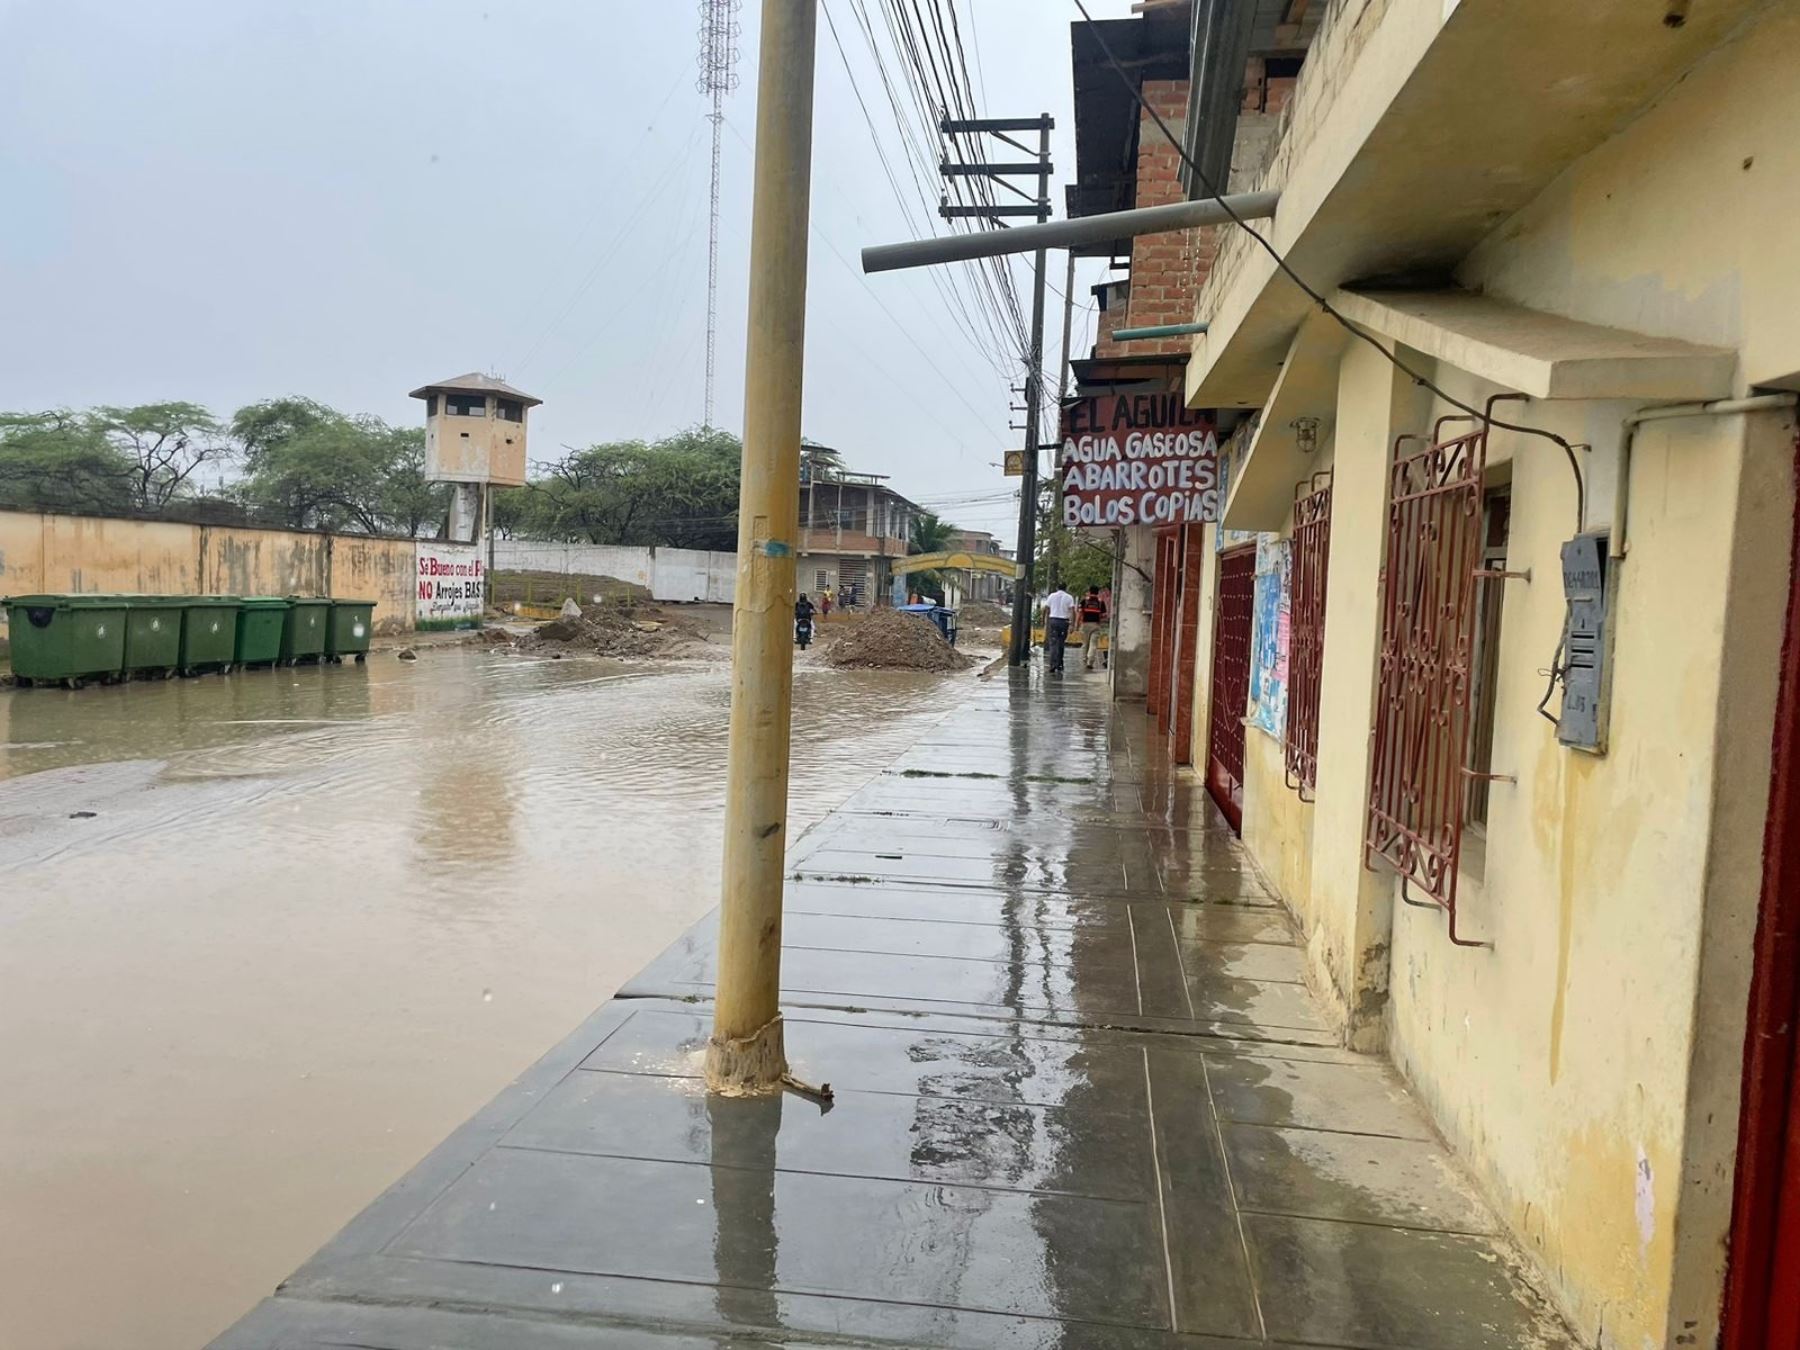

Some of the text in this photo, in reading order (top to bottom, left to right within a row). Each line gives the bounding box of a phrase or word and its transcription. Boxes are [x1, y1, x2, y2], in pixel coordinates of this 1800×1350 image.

[1070, 398, 1105, 432] EL
[1062, 431, 1218, 463] AGUA GASEOSA
[1063, 459, 1216, 491] ABARROTES
[430, 557, 454, 576] Bueno
[420, 581, 432, 600] NO
[436, 581, 462, 606] Arrojes
